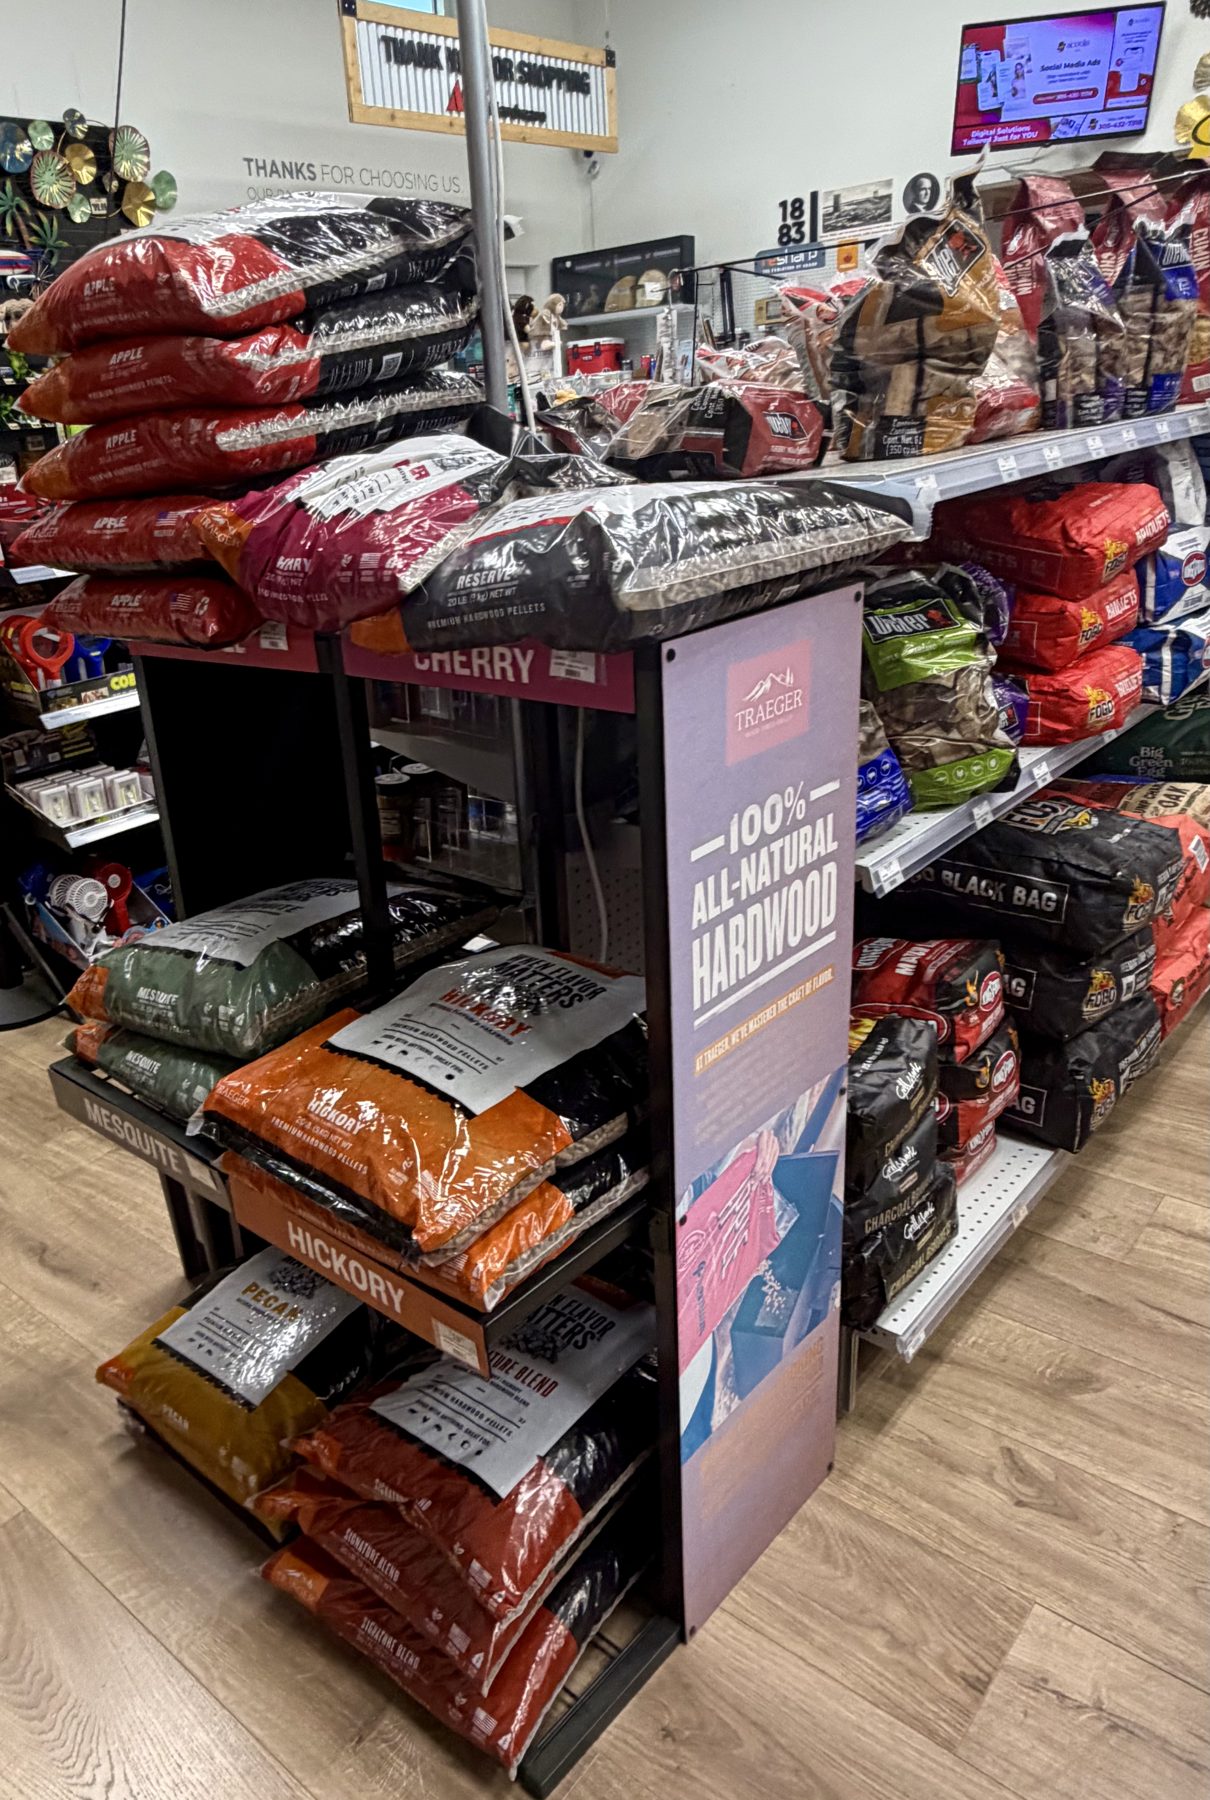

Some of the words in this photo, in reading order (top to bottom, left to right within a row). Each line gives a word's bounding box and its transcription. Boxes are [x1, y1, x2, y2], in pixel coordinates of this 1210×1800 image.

[381, 35, 443, 71] THANK
[492, 55, 514, 82] OR
[516, 60, 592, 96] SHOPPING
[1040, 63, 1062, 72] Social
[1063, 60, 1086, 69] Media
[1087, 58, 1101, 66] Ads
[971, 128, 996, 140] Digital
[997, 124, 1031, 135] Solutions
[1022, 130, 1039, 139] YOU
[242, 157, 317, 182] THANKS
[321, 164, 355, 185] FOR
[359, 167, 439, 192] CHOOSING
[441, 176, 462, 194] US
[778, 197, 805, 222] 18
[777, 221, 806, 246] 83
[83, 278, 116, 296] APPLE
[108, 346, 144, 365] APPLE
[105, 429, 137, 449] APPLE
[93, 515, 128, 529] APPLE
[456, 569, 513, 590] RESERVE
[110, 594, 143, 607] APPLE
[447, 597, 458, 607] 20
[489, 588, 504, 599] NET
[462, 607, 505, 623] HARDWOOD
[506, 602, 547, 616] PELLETS
[412, 646, 535, 685] CHERRY
[735, 688, 803, 732] TRAEGER
[1089, 699, 1114, 721] FOGO
[1128, 755, 1174, 768] Green
[1140, 746, 1166, 760] Big
[1158, 785, 1190, 808] OAK
[729, 781, 806, 855] 100%
[692, 812, 839, 931] ALL-NATURAL
[940, 869, 1005, 903] BLACK
[1012, 887, 1058, 913] BAG
[692, 861, 838, 1012] HARDWOOD
[549, 966, 608, 1001] FLAVOR
[1085, 985, 1117, 1010] FOGO
[695, 1054, 705, 1072] AT
[777, 998, 789, 1013] THE
[125, 1050, 162, 1075] MESQUITE
[458, 1050, 490, 1070] PELLETS
[306, 1098, 366, 1135] HICKORY
[83, 1097, 183, 1175] MESQUITE
[337, 1152, 369, 1175] PELLETS
[864, 1202, 911, 1235] CHARCOAL
[287, 1220, 405, 1314] HICKORY
[241, 1281, 303, 1322] PECAN
[560, 1299, 617, 1342] FLAVOR
[513, 1365, 559, 1398] BLEND
[161, 1403, 190, 1432] PECAN
[450, 1395, 485, 1420] HARDWOOD
[485, 1416, 514, 1437] PELLETS
[343, 1527, 381, 1565] SIGNATURE
[376, 1556, 401, 1583] BLEND
[360, 1616, 398, 1653] SIGNATURE
[395, 1643, 421, 1670] BLEND
